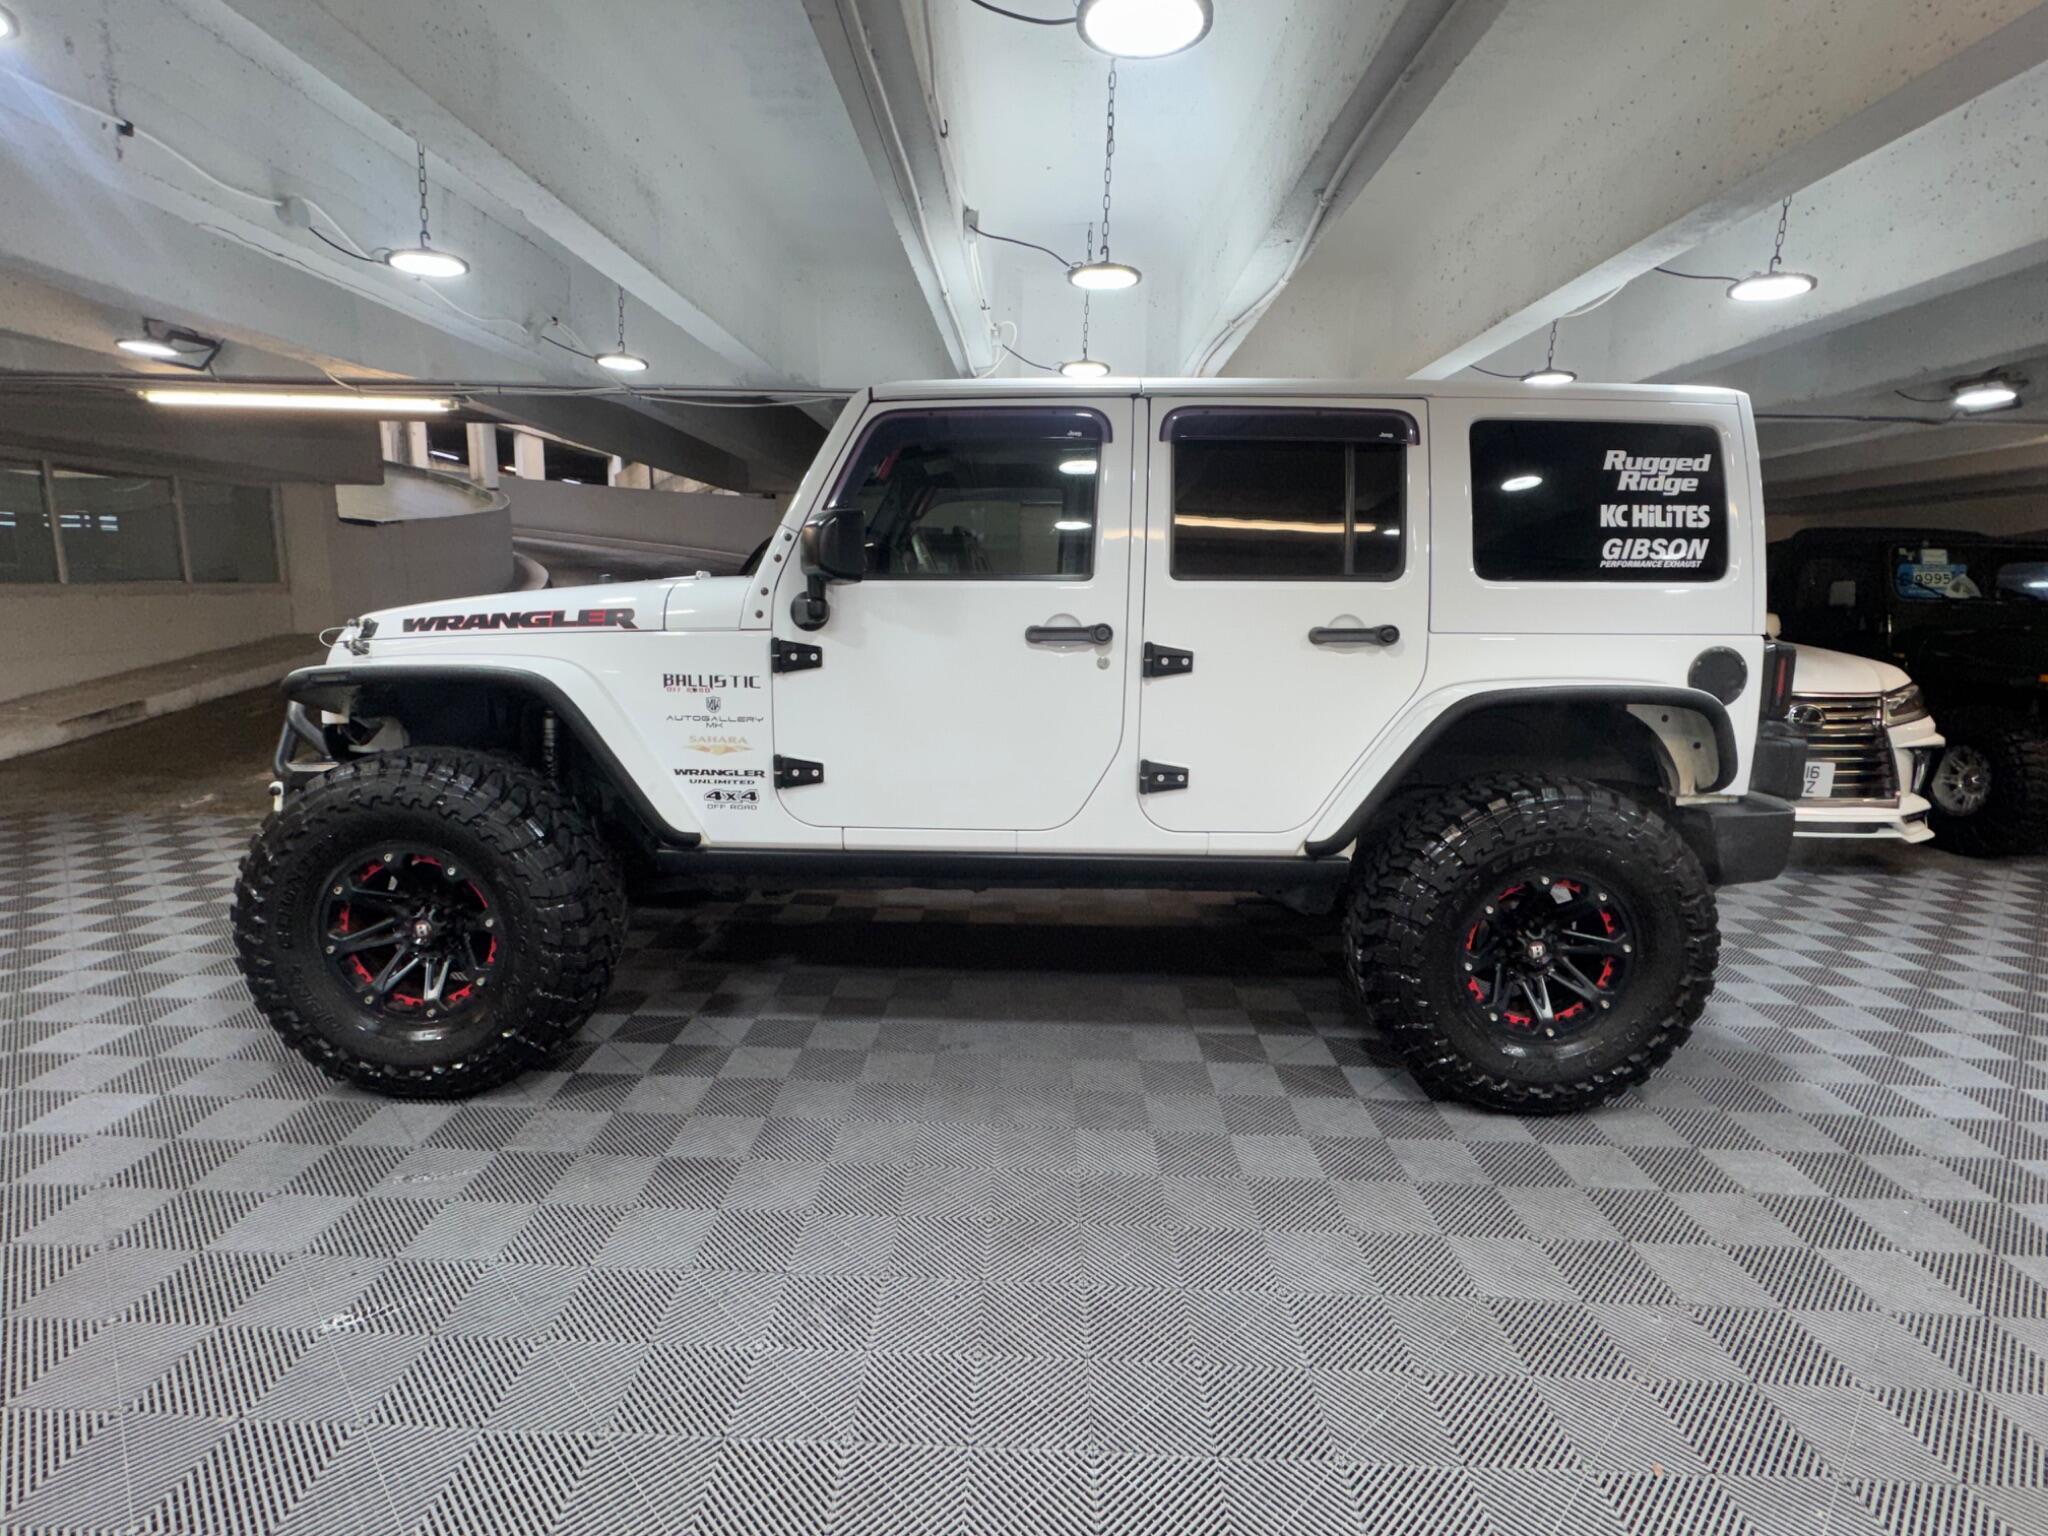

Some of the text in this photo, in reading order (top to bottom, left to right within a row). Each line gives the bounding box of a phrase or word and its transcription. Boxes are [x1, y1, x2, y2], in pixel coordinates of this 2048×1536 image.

[1603, 449, 1712, 475] Rugged
[1617, 470, 1699, 496] Ridge
[1600, 504, 1628, 528] KC
[1602, 538, 1710, 560] GIBSON
[1663, 560, 1702, 568] EXHAUST
[402, 607, 639, 633] WRANGLER
[663, 673, 761, 689] BALLISTIC
[666, 715, 764, 723] AUTOGALLERY
[689, 735, 748, 744] SAHARA
[674, 768, 766, 778] WRANGLER
